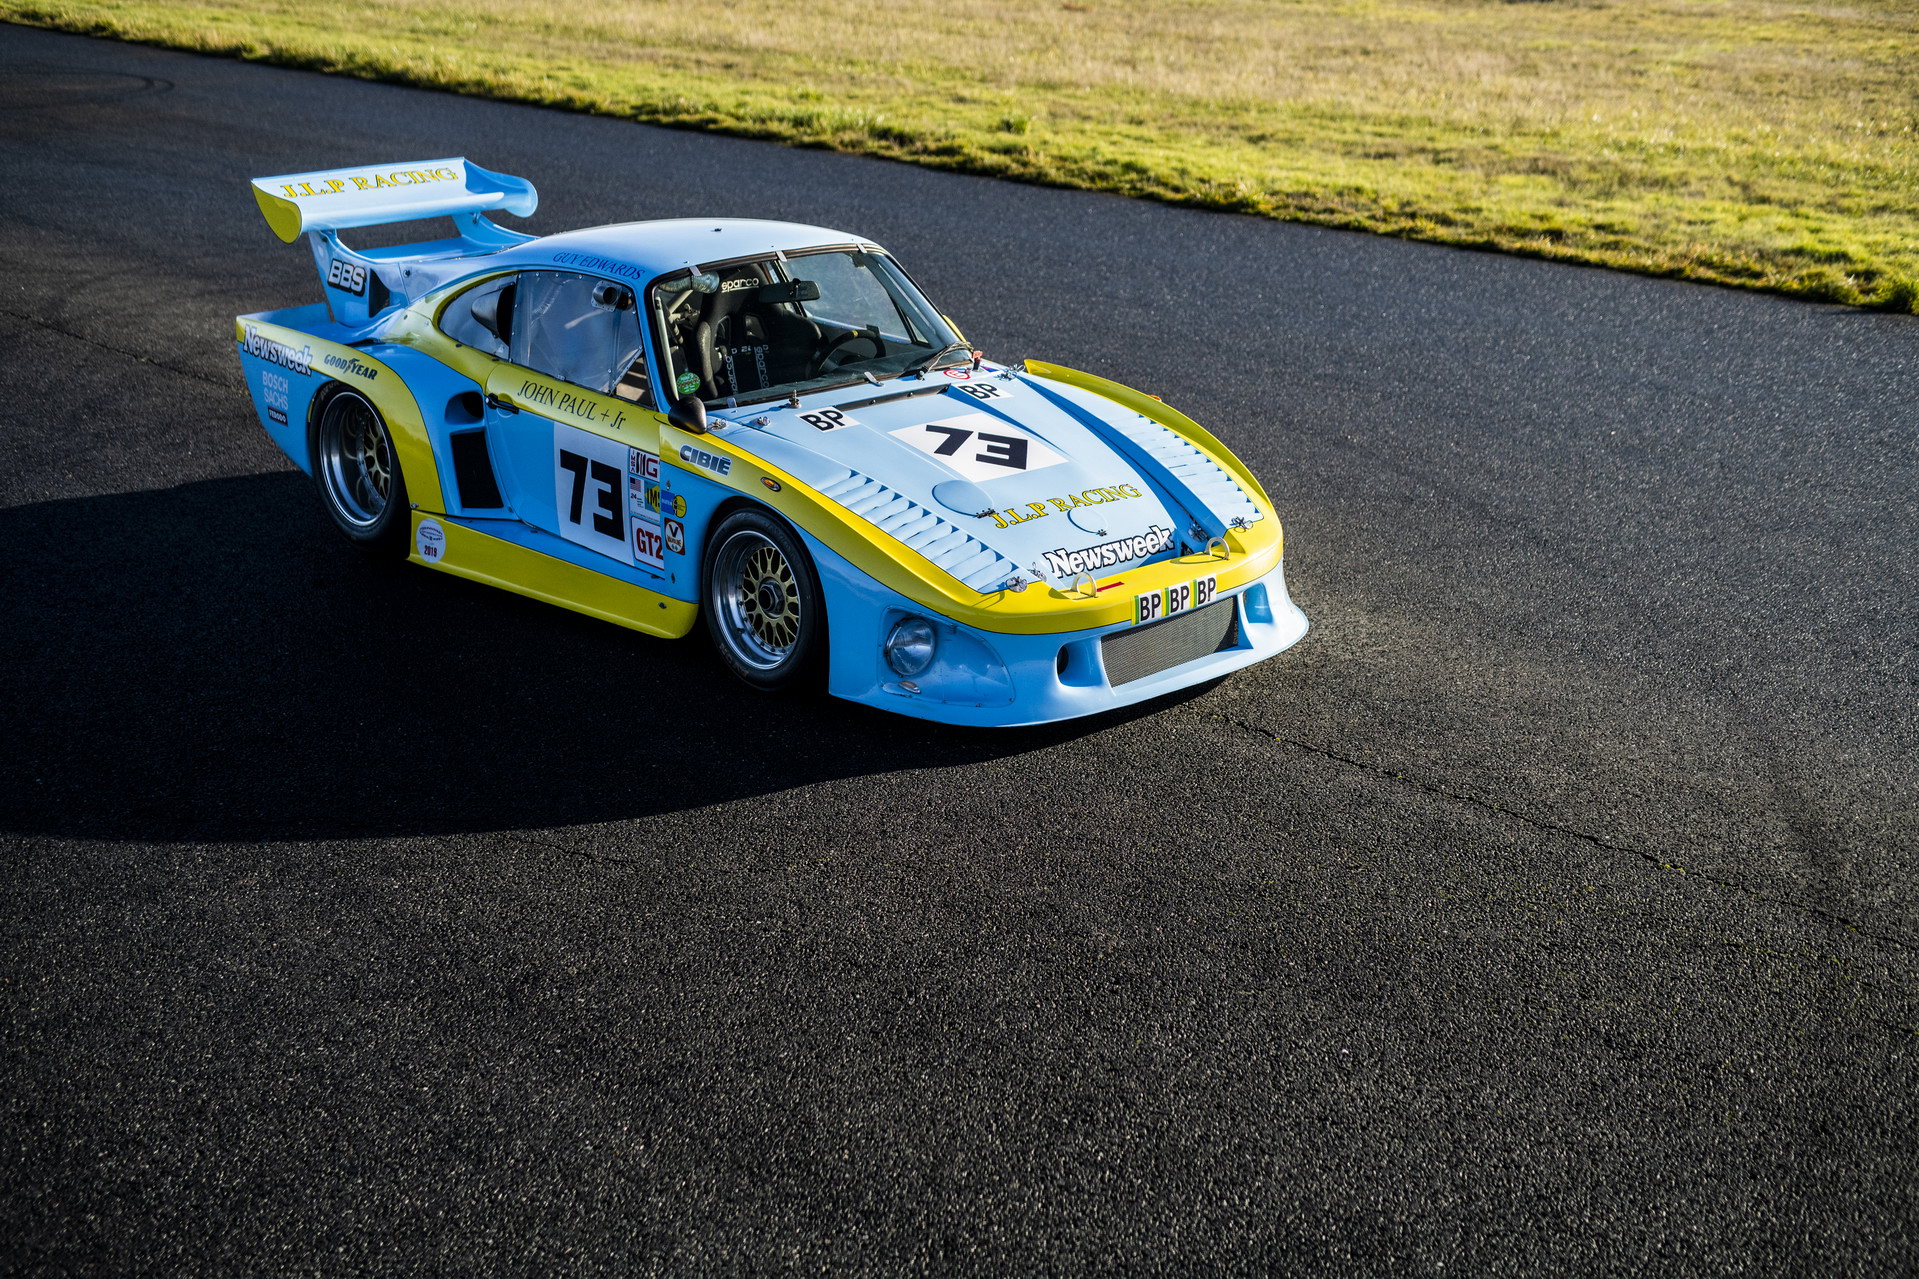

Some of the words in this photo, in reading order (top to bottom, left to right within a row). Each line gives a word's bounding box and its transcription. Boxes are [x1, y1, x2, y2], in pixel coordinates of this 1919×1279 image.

[280, 179, 345, 198] J.L.P
[349, 167, 459, 191] RACING
[327, 258, 367, 297] BBS
[553, 252, 580, 265] GUY
[579, 256, 646, 280] EDWARDS
[721, 278, 760, 293] sparco
[243, 325, 313, 377] Newsweek
[323, 353, 378, 381] GOODYEAR
[754, 346, 770, 389] sparco
[262, 371, 289, 394] BOSCH
[263, 387, 289, 411] SACHS
[957, 383, 1000, 399] BP
[517, 380, 560, 407] JOHN
[557, 393, 598, 421] PAUL
[600, 409, 610, 422] +
[610, 410, 627, 430] Jr
[800, 409, 845, 432] BP
[925, 424, 1028, 470] 73
[559, 448, 626, 542] 73
[991, 501, 1050, 529] J.L.P
[1046, 483, 1143, 512] RACING
[636, 526, 664, 560] GT2
[1042, 525, 1176, 579] Newsweek
[1140, 593, 1161, 621] BP
[1169, 584, 1190, 613] BP
[1197, 577, 1217, 606] BP
